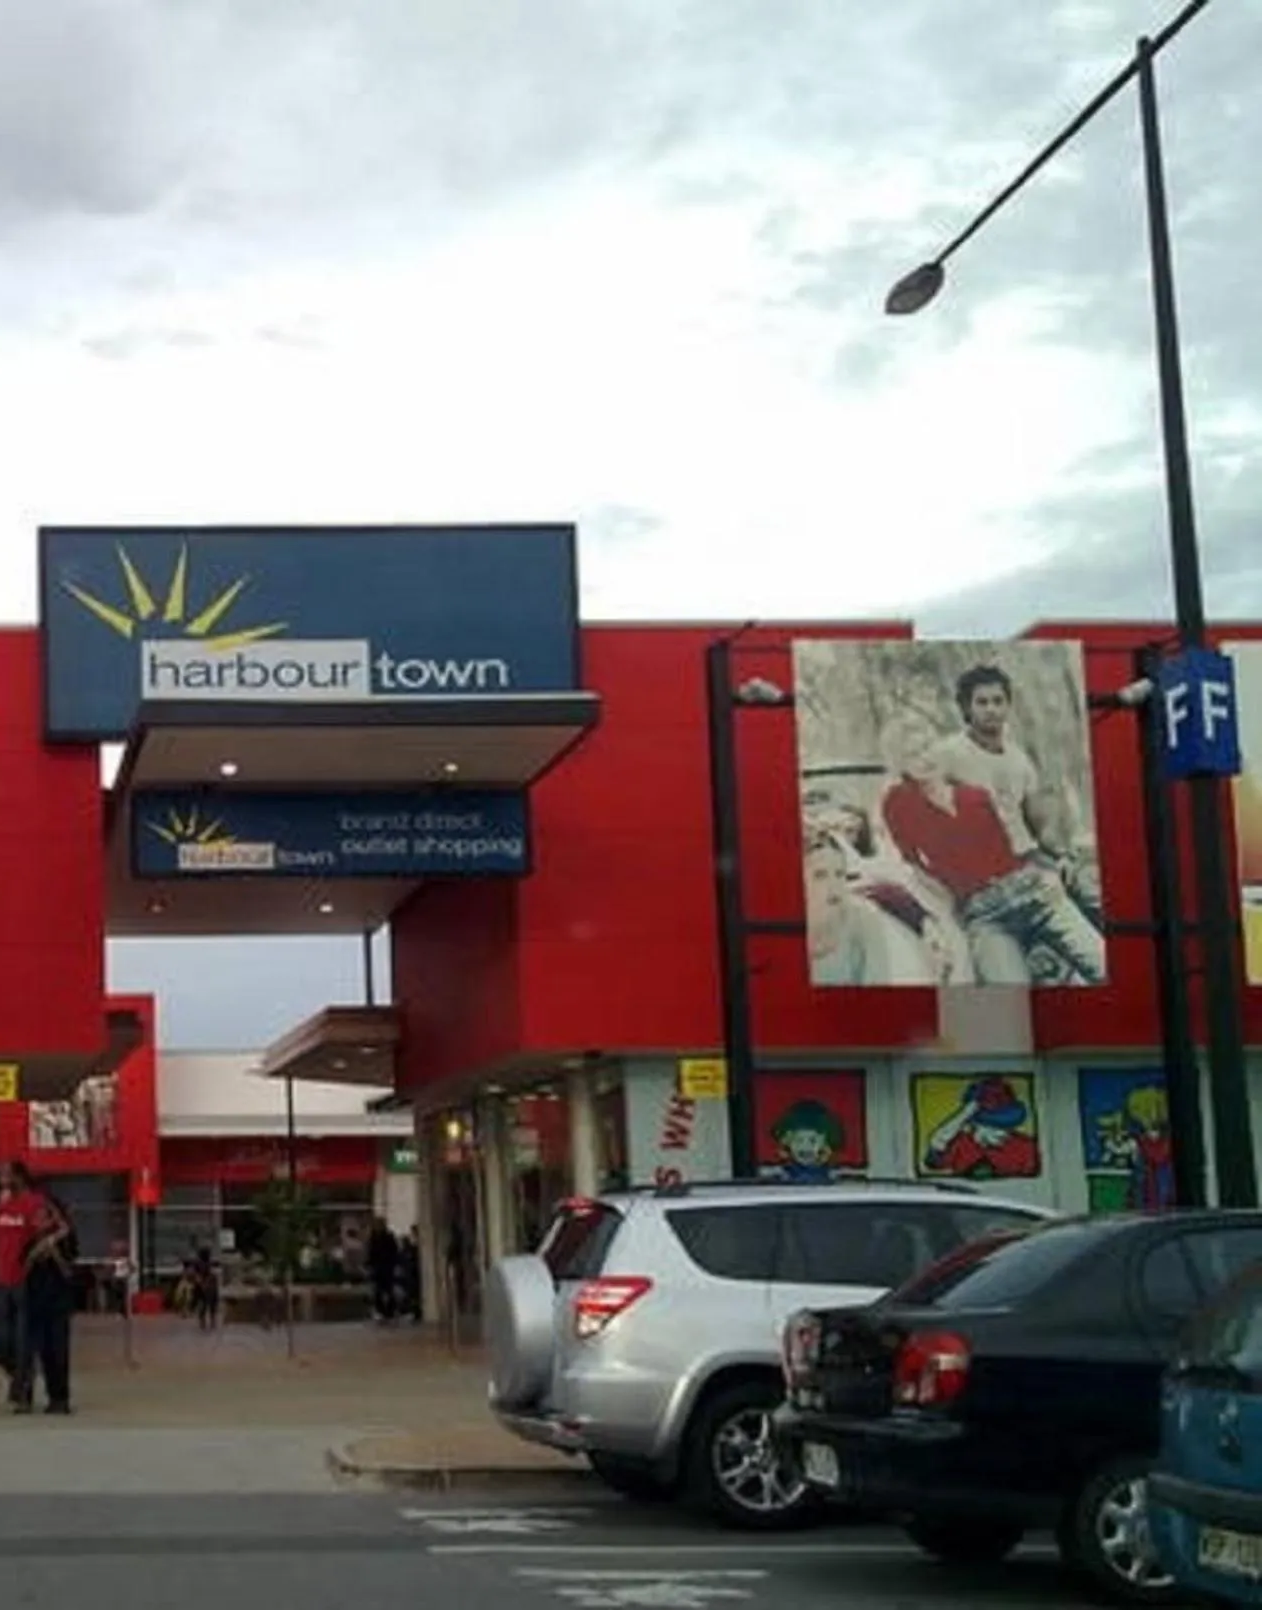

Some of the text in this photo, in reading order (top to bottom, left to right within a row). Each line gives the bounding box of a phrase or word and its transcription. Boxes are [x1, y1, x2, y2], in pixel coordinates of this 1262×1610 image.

[149, 651, 509, 689] harbour town
[340, 835, 522, 859] outlet shopping
